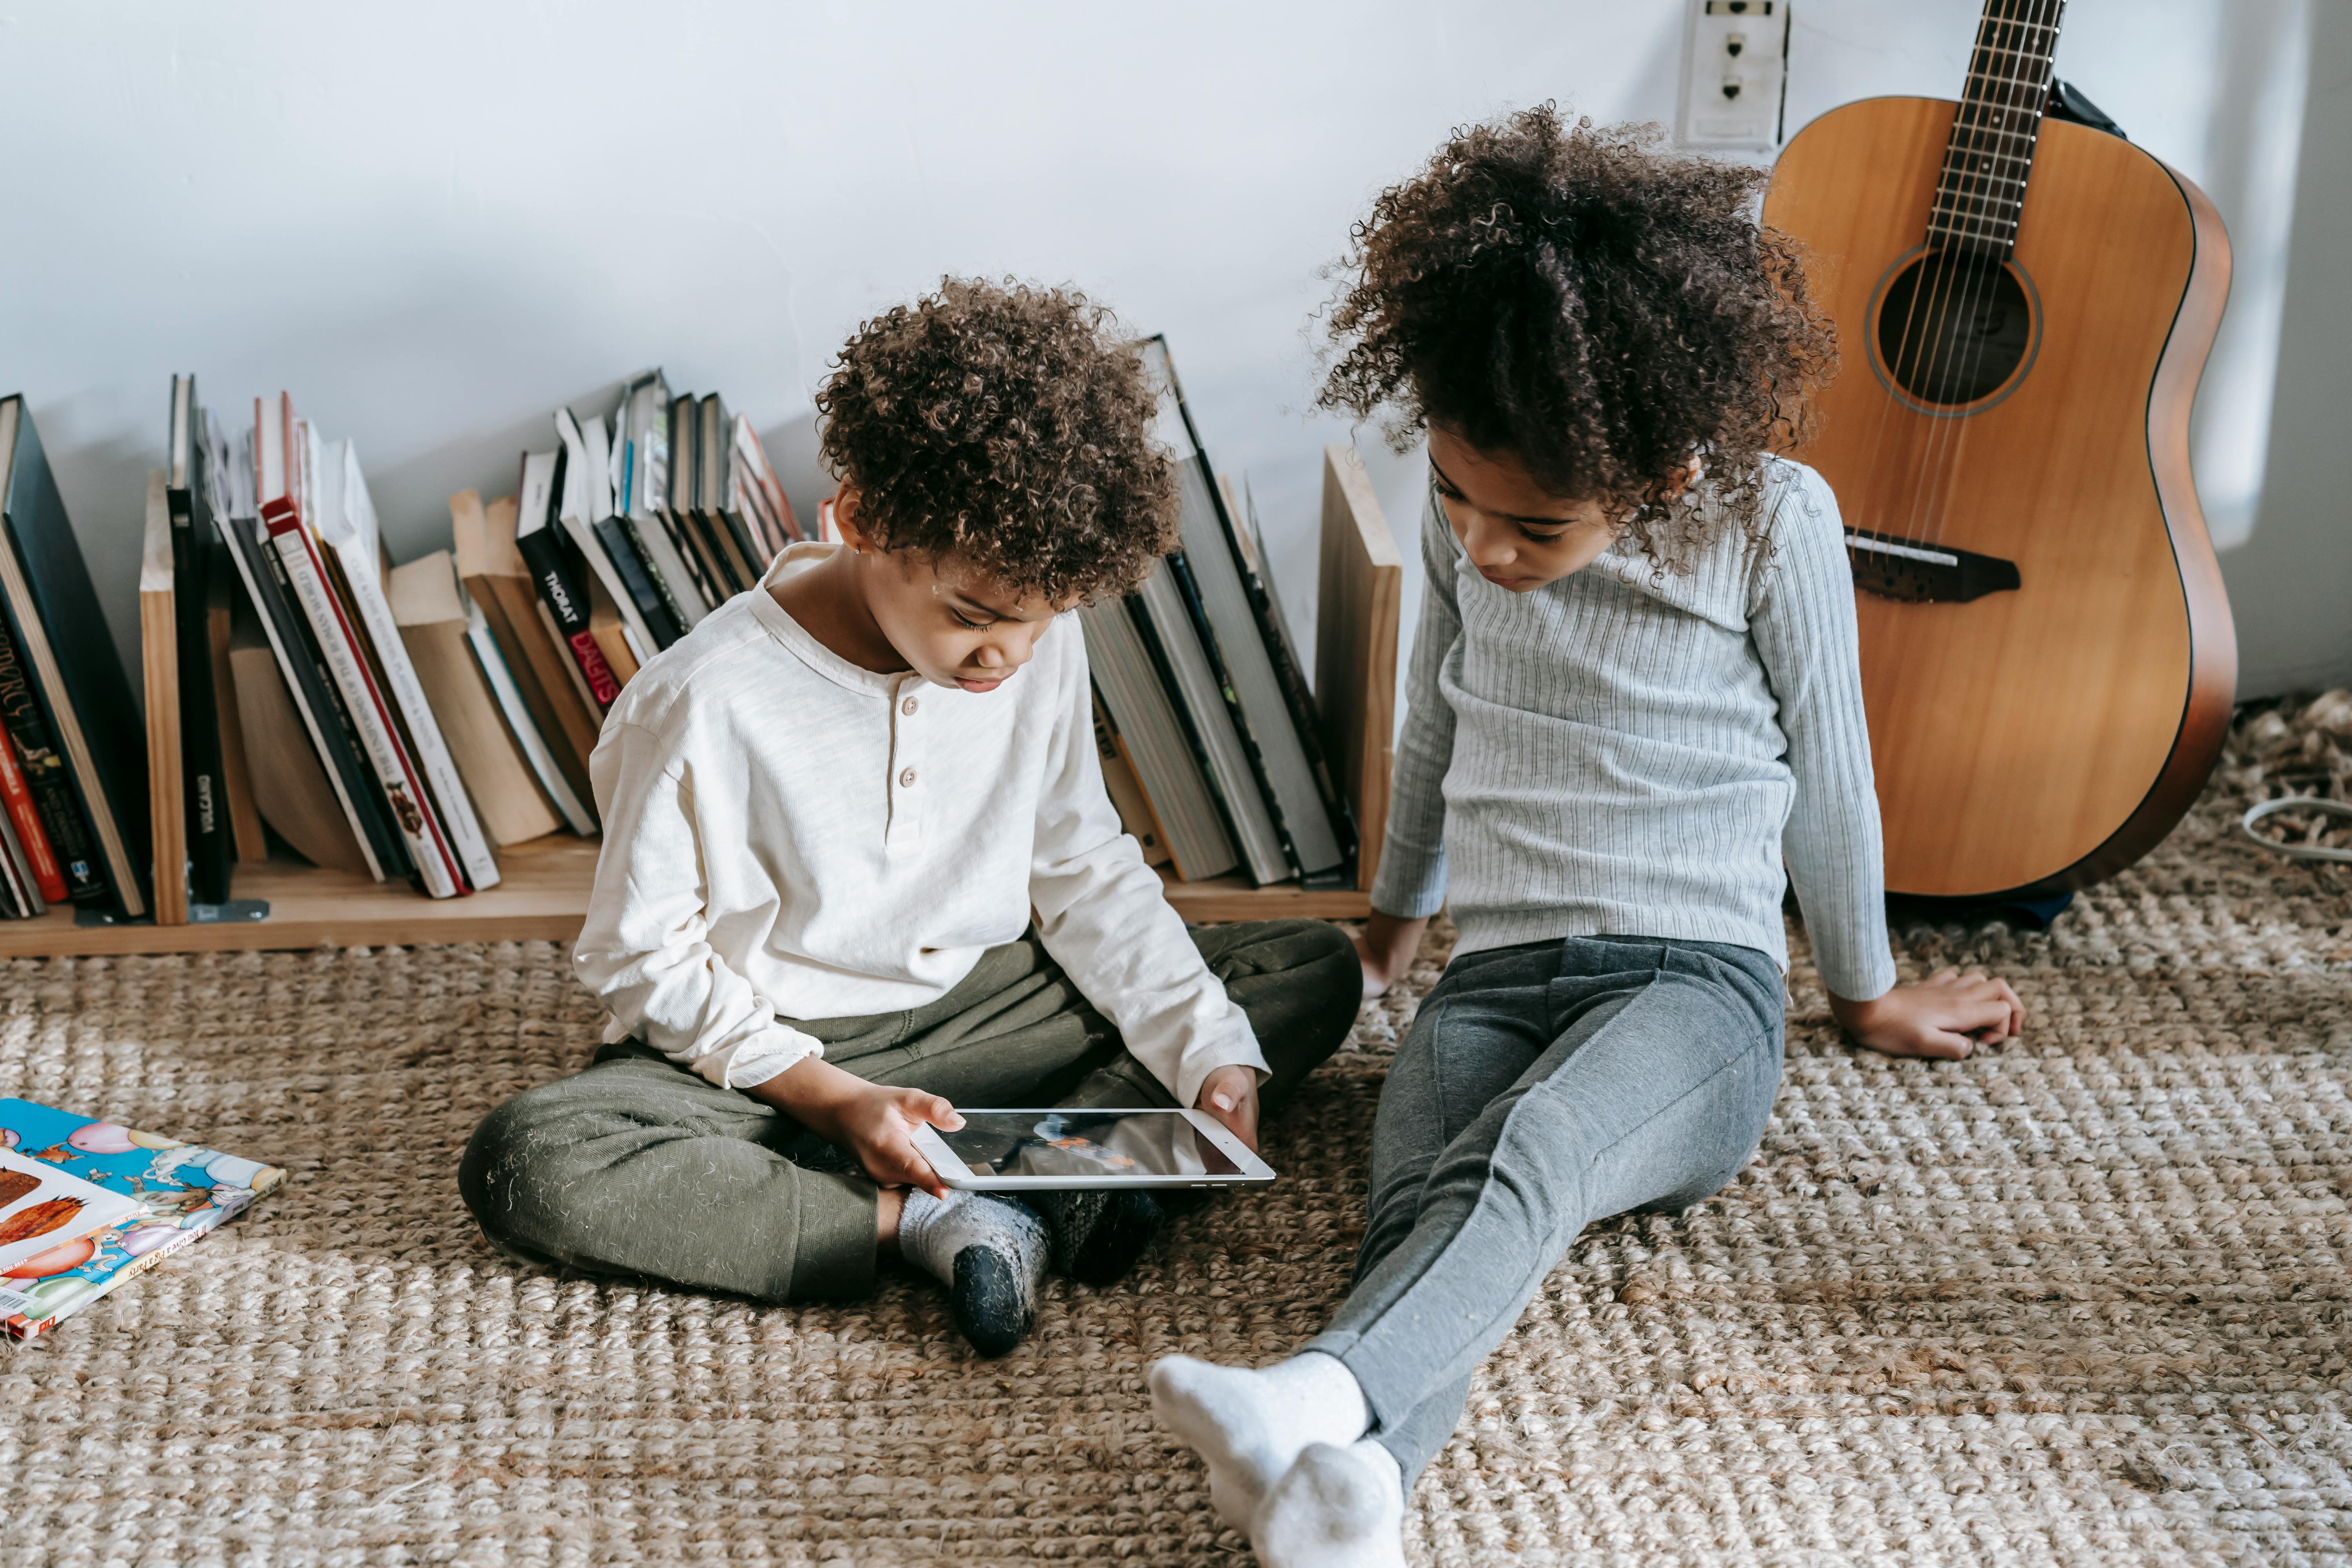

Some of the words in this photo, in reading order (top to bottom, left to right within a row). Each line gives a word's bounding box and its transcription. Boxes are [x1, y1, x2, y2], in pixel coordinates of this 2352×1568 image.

[297, 569, 323, 613] WORLD
[544, 570, 578, 623] THORAT
[363, 592, 381, 617] LIME
[316, 611, 341, 655] ROMAN
[334, 654, 352, 678] THE
[345, 677, 360, 697] OF
[352, 695, 385, 753] UNIFORMS
[378, 753, 395, 777] THE
[110, 1217, 126, 1228] HENRY
[201, 1225, 207, 1235] If
[172, 1238, 186, 1250] Give
[188, 1230, 200, 1240] You
[155, 1250, 165, 1263] Pig
[129, 1260, 147, 1277] Party
